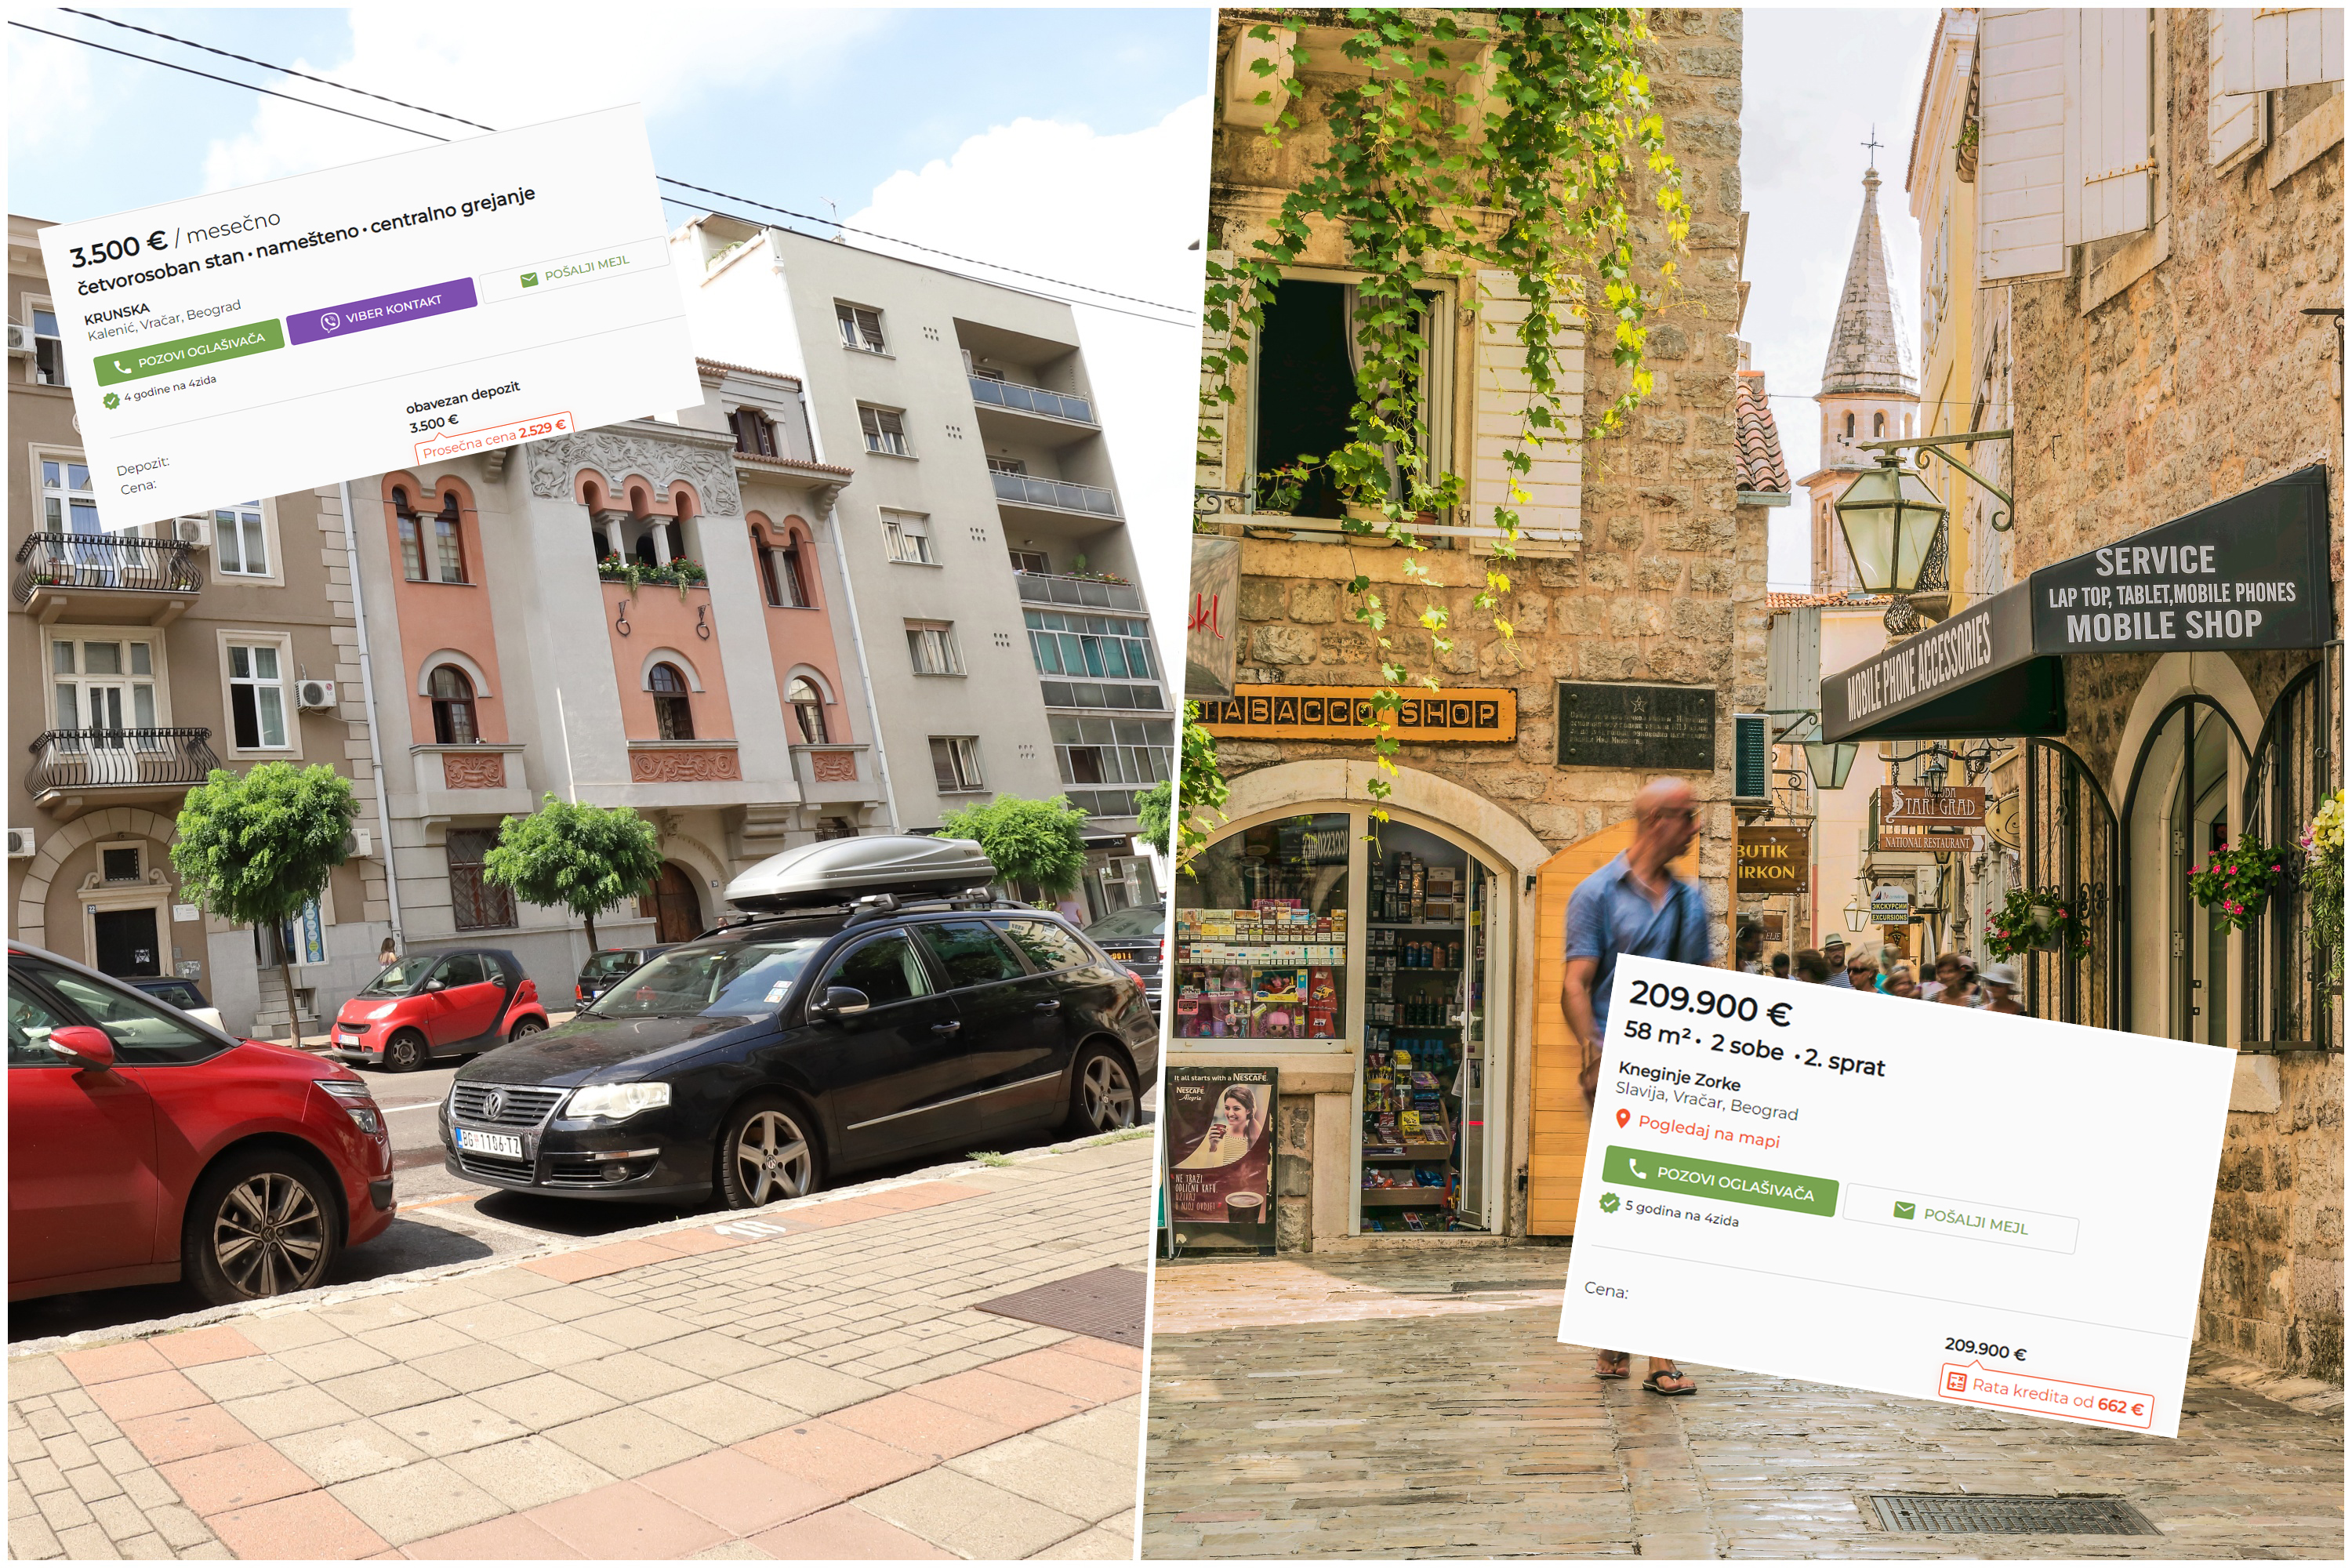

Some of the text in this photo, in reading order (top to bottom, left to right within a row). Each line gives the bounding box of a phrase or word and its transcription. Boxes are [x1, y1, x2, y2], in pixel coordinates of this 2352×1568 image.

[2095, 545, 2216, 576] SERVICE
[2049, 587, 2078, 608] LAP
[2082, 586, 2113, 608] TOP,
[2235, 583, 2296, 602] PHONES
[2067, 609, 2263, 643] MOBILE SHOP
[1847, 618, 1992, 723] MOBILE PHONE ACCESSORIES
[1199, 699, 1495, 725] TABACCO SHOP
[1940, 798, 1976, 816] GRAD
[1885, 837, 1970, 849] NATIONAL RESTAURANT
[1737, 844, 1788, 858] BUTIK
[1179, 1094, 1202, 1102] Alegria
[463, 1131, 474, 1147] BG
[1176, 1174, 1203, 1184] NE TRAŽI
[1175, 1182, 1199, 1193] ODLIČNU
[1176, 1192, 1196, 1202] UŽIVAJ
[1181, 1202, 1194, 1210] NJOJ
[1196, 1202, 1216, 1211] OVDJE!
